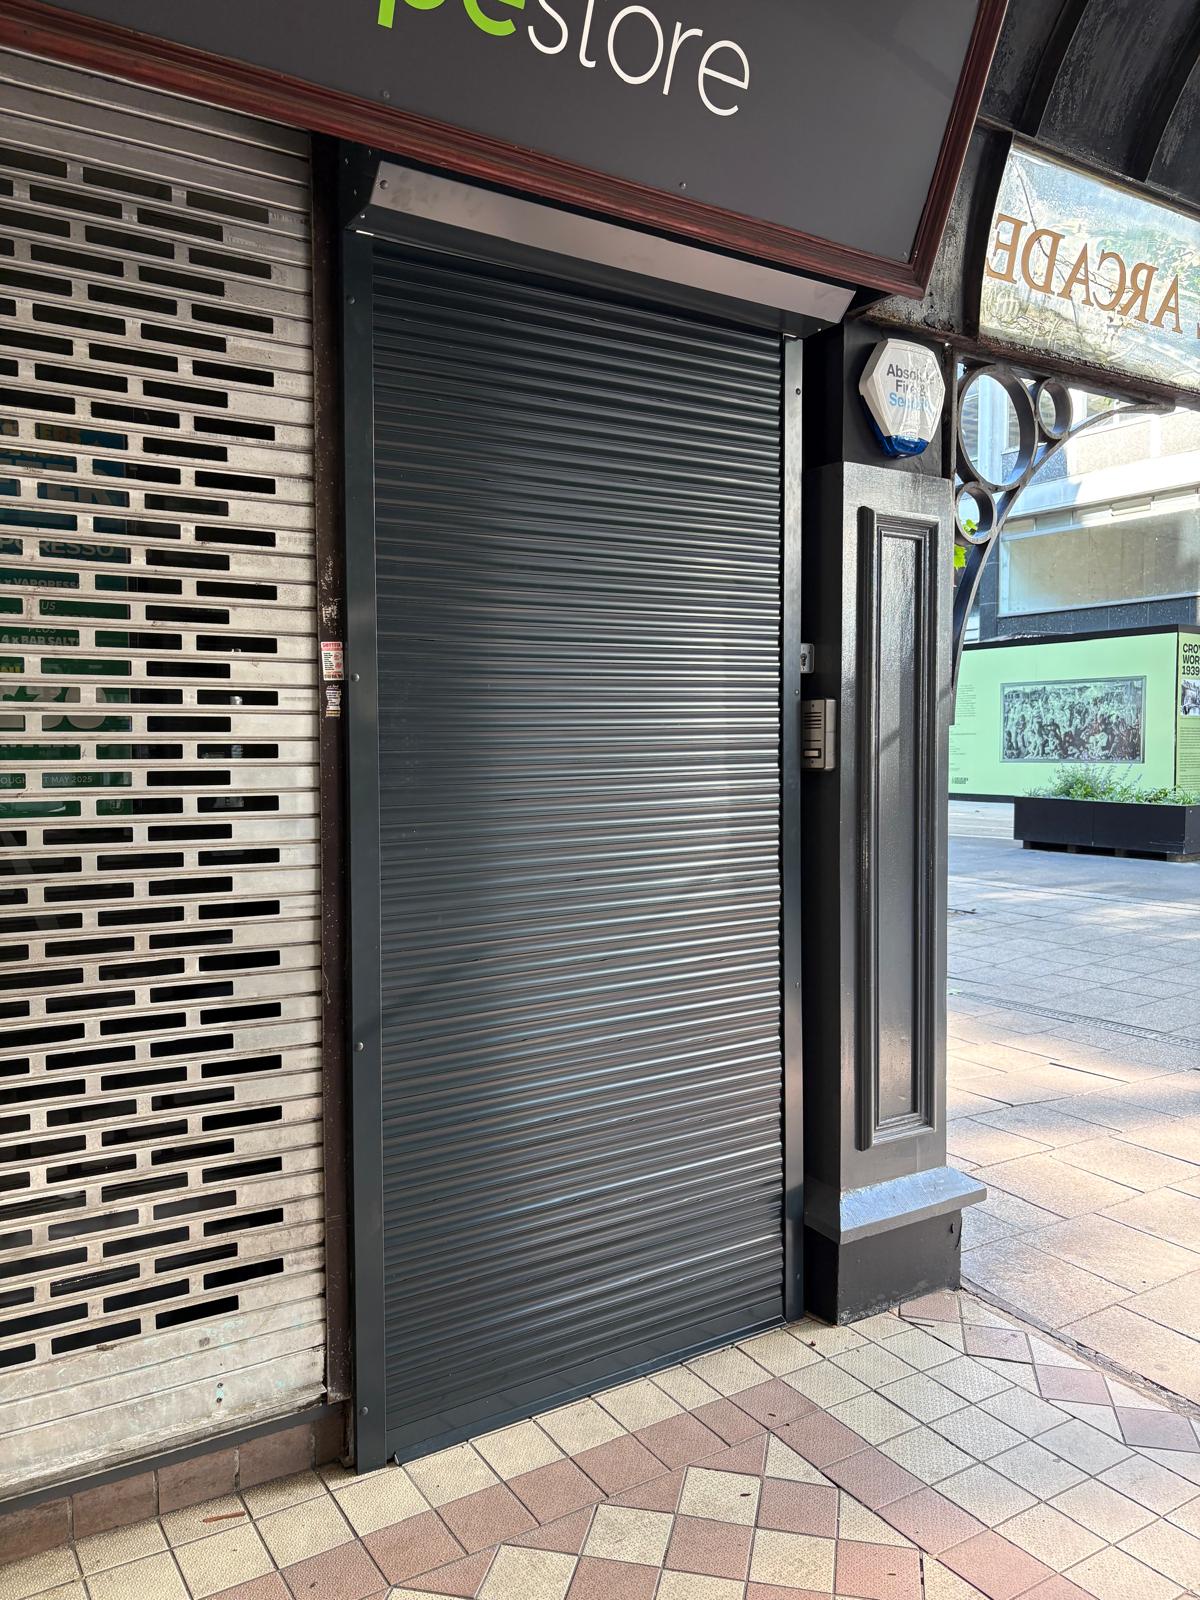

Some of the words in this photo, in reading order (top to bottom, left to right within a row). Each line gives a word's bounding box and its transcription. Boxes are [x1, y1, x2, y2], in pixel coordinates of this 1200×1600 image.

[13, 578, 79, 589] VAPORESS
[51, 775, 70, 784] MAY
[71, 775, 93, 783] 2025
